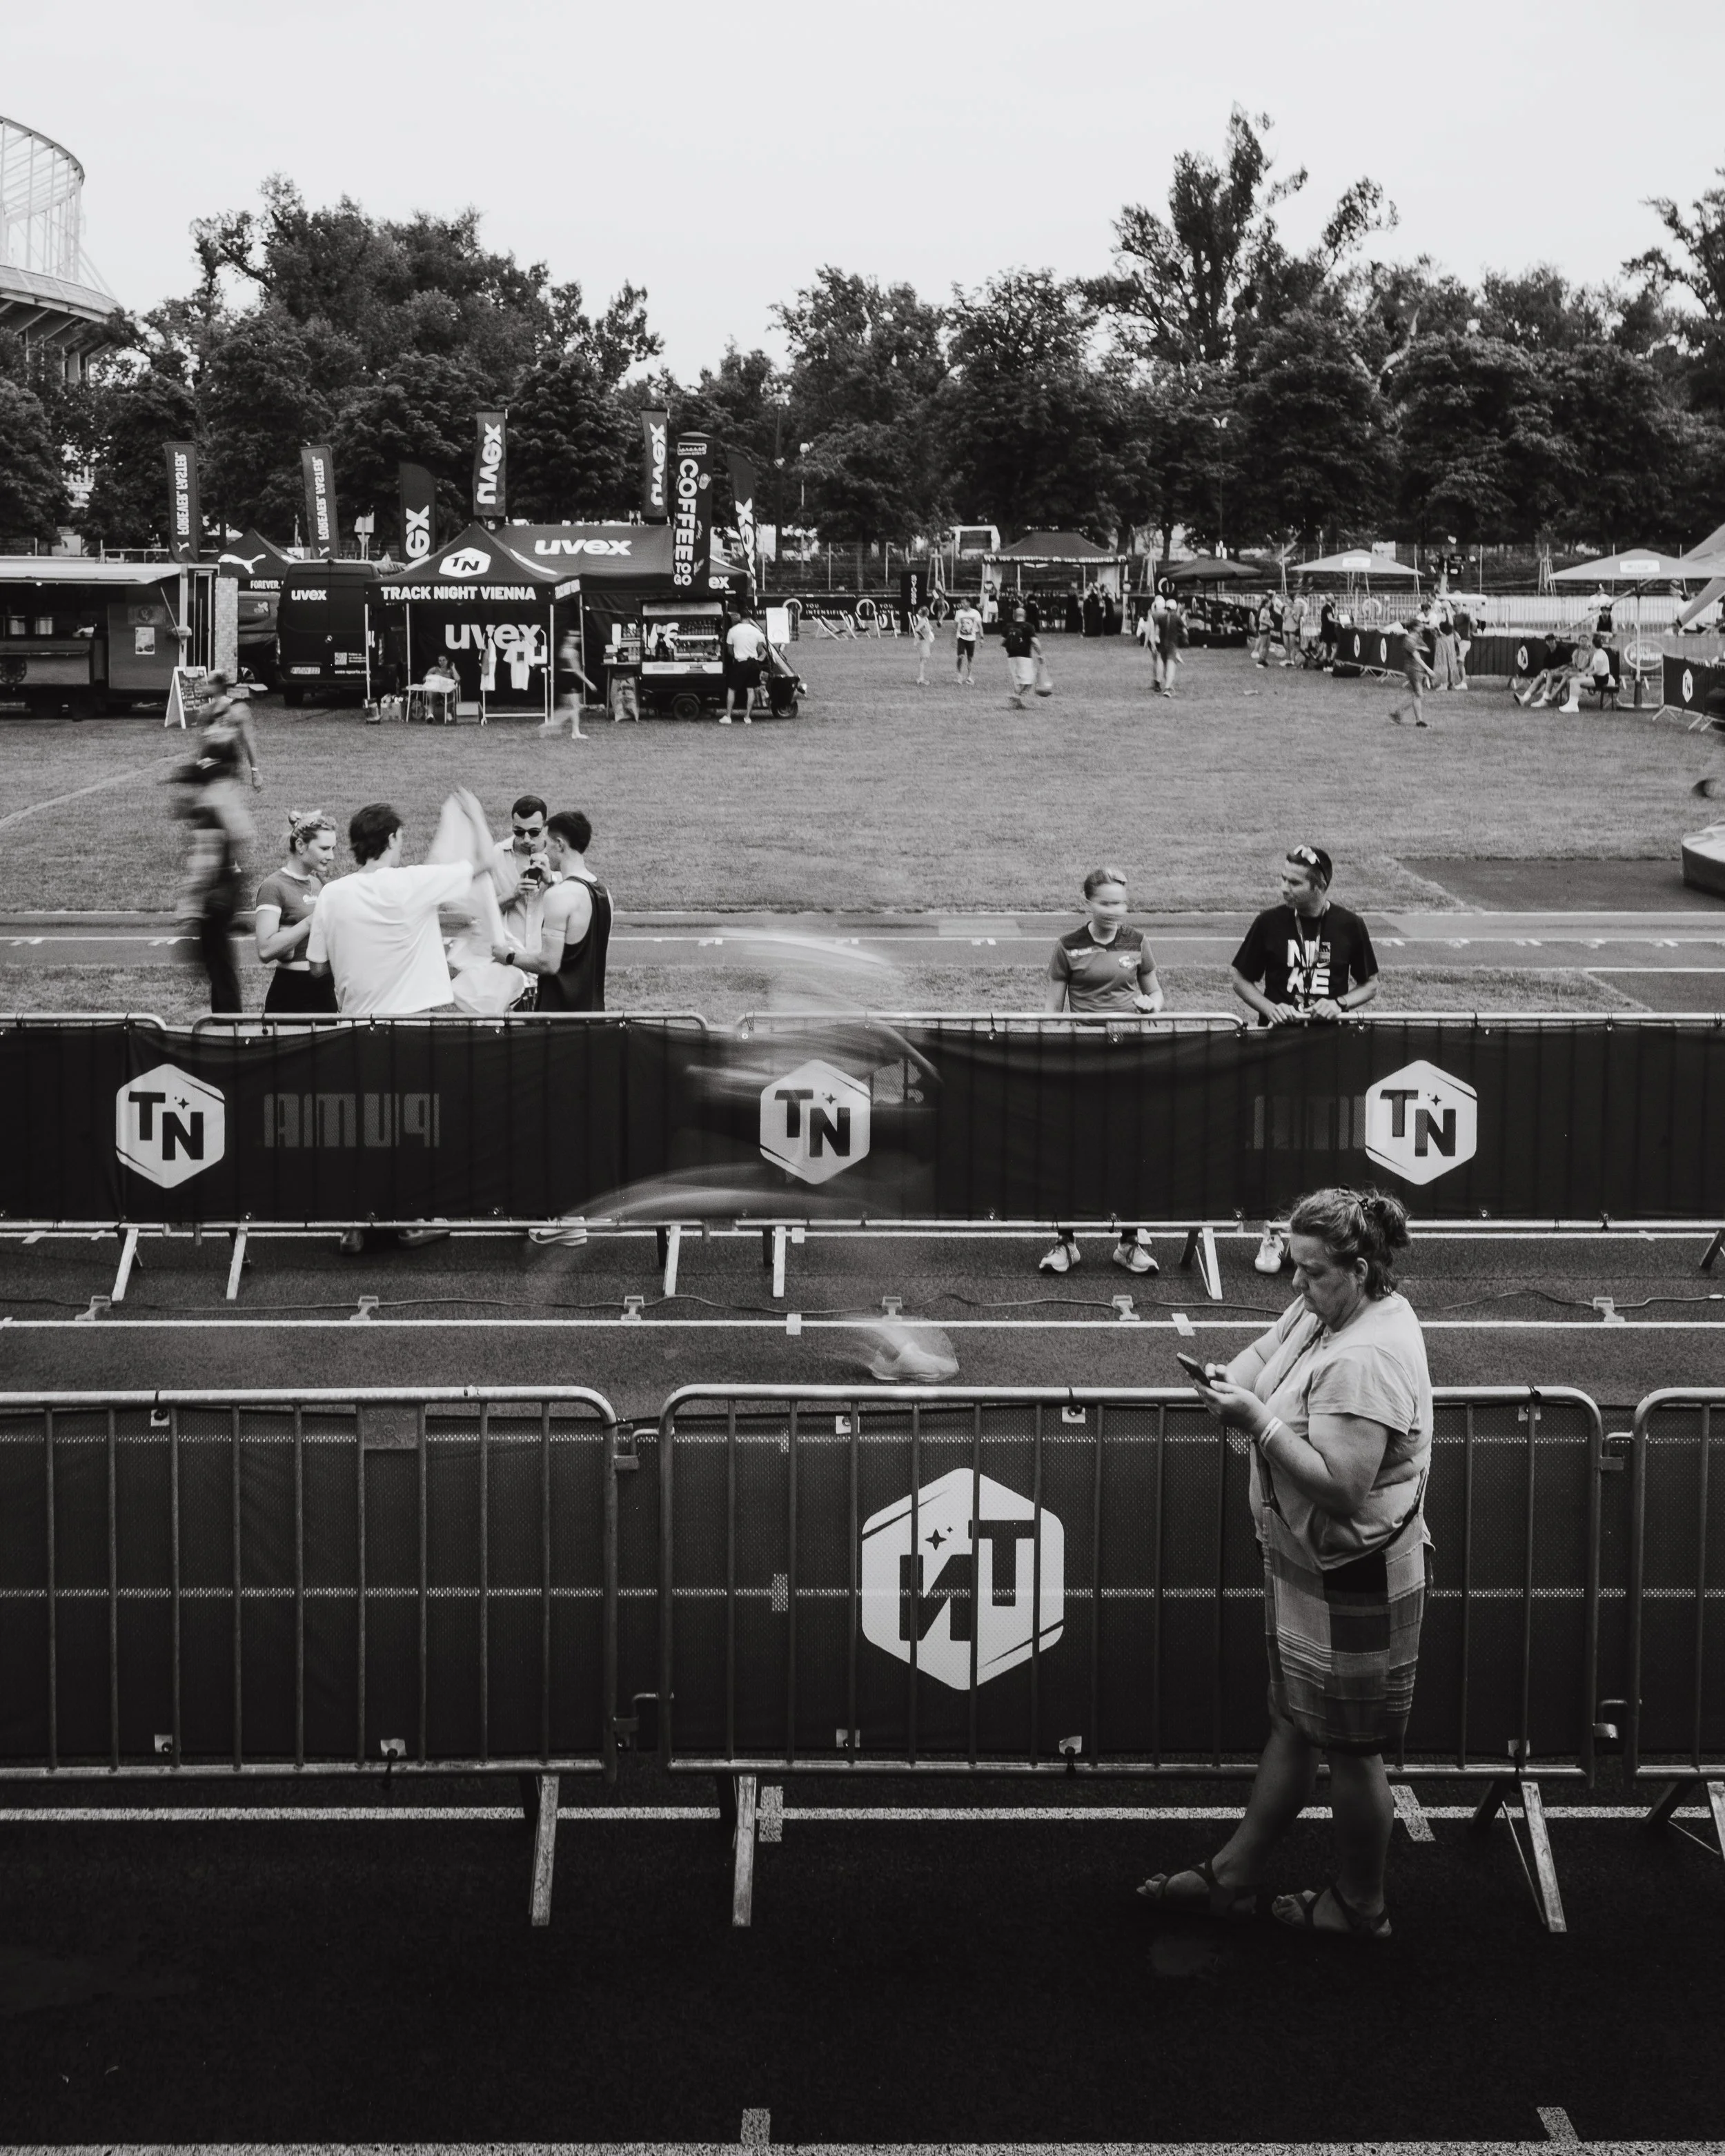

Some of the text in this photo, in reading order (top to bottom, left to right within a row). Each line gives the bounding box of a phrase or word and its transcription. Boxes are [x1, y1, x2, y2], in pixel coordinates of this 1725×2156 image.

[675, 458, 699, 561] COFFEE
[534, 539, 632, 556] uvex
[450, 556, 480, 571] TN
[676, 562, 691, 573] TO
[673, 574, 692, 586] GO
[709, 576, 730, 589] ex
[291, 589, 327, 601] uvex
[381, 586, 536, 600] TRACK NIGHT VIENNA
[445, 624, 542, 650] uvex
[128, 1091, 204, 1160] TN
[775, 1089, 850, 1158] TN
[1380, 1089, 1457, 1157] TN
